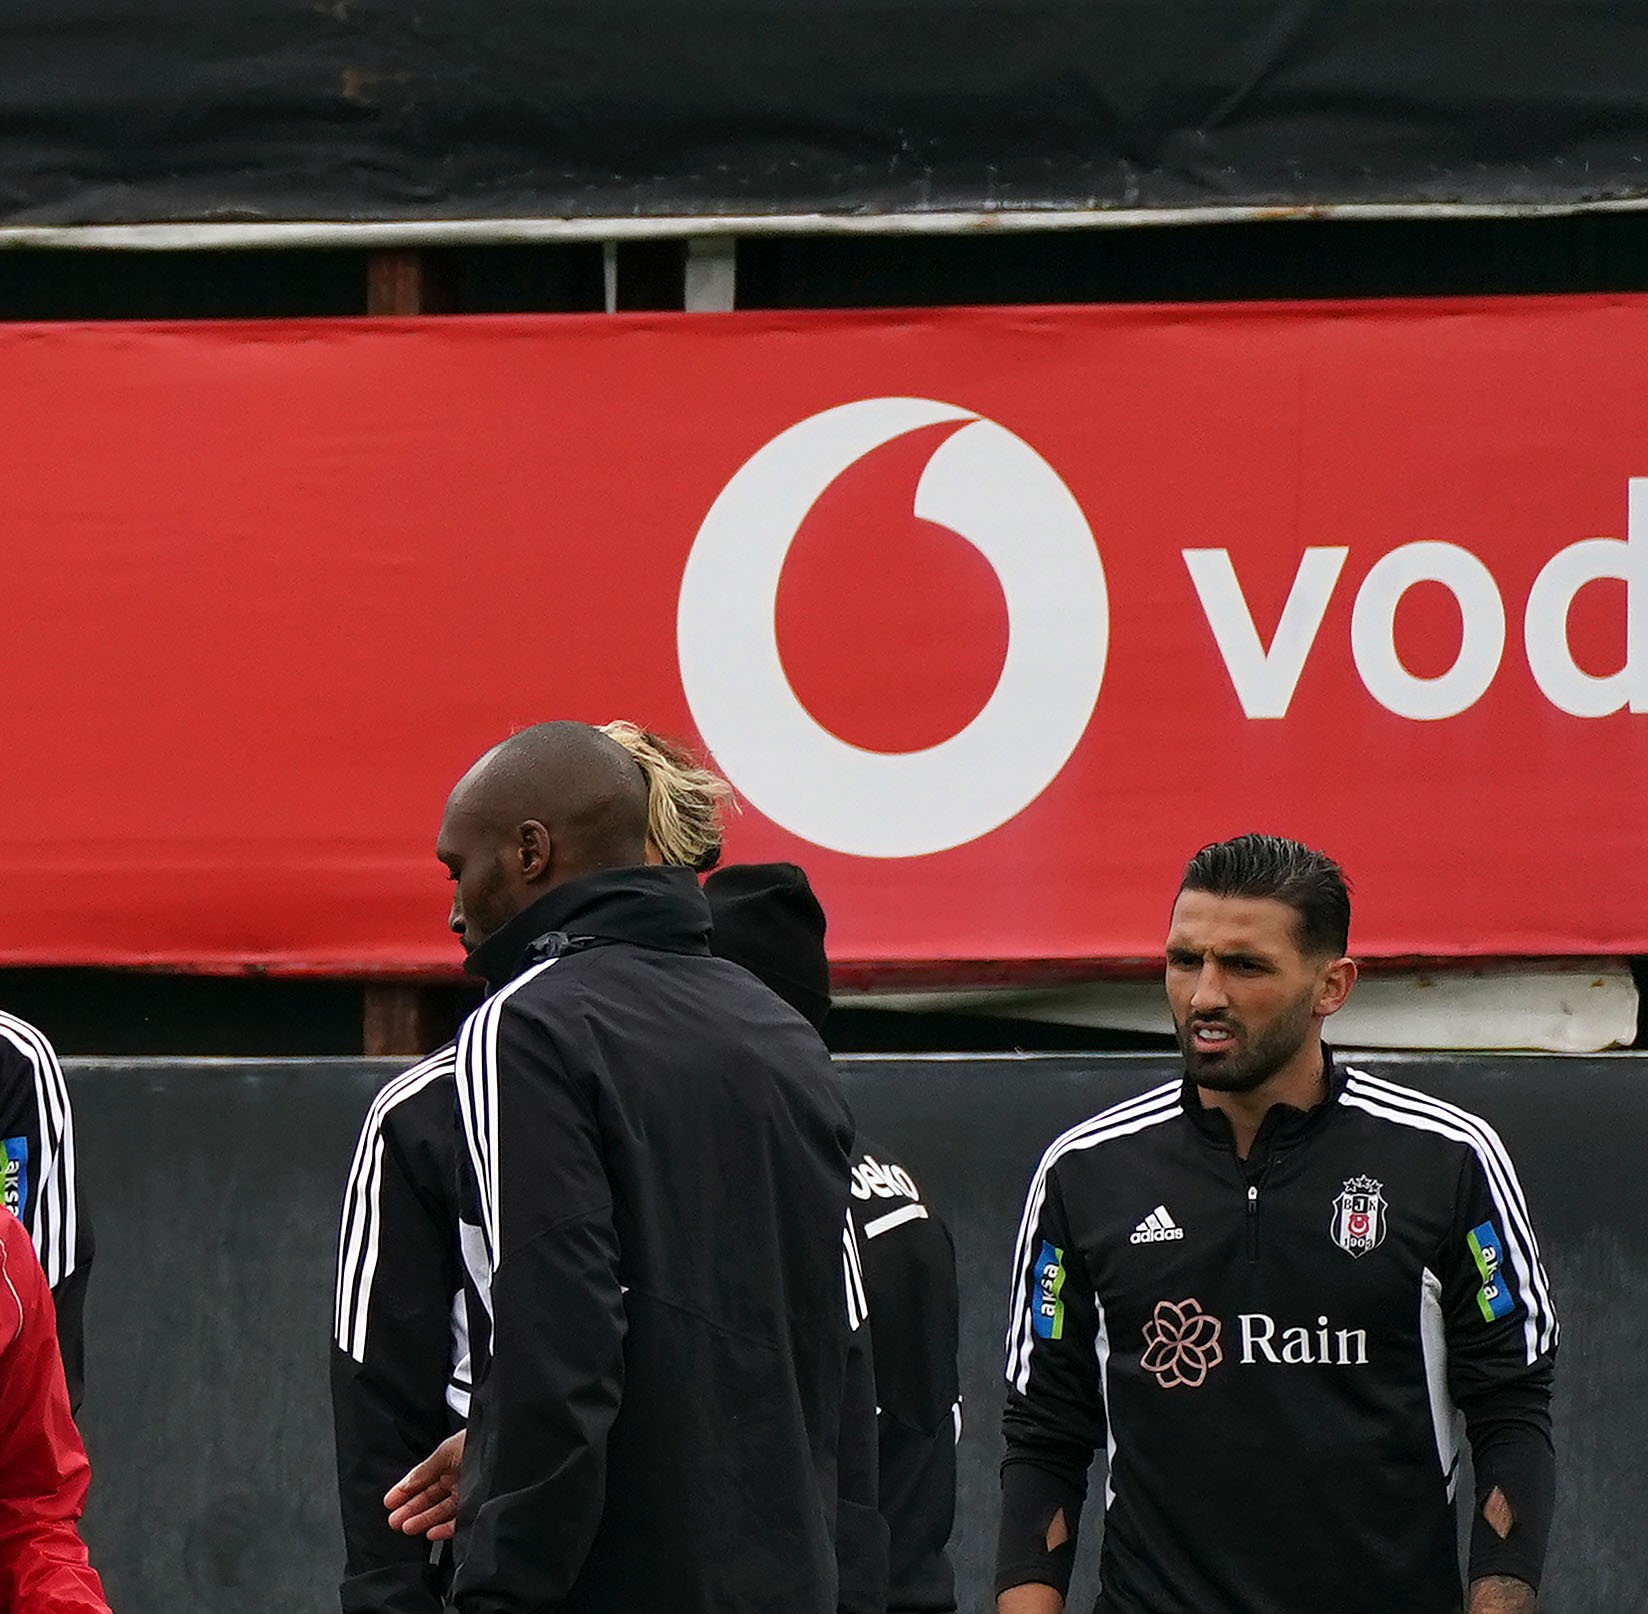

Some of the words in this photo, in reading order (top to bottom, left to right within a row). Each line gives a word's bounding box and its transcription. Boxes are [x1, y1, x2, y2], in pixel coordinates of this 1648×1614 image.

[1129, 1227, 1184, 1245] adidas
[1040, 1263, 1058, 1317] aksa
[1480, 1245, 1499, 1301] aka
[1237, 1313, 1369, 1365] Rain
